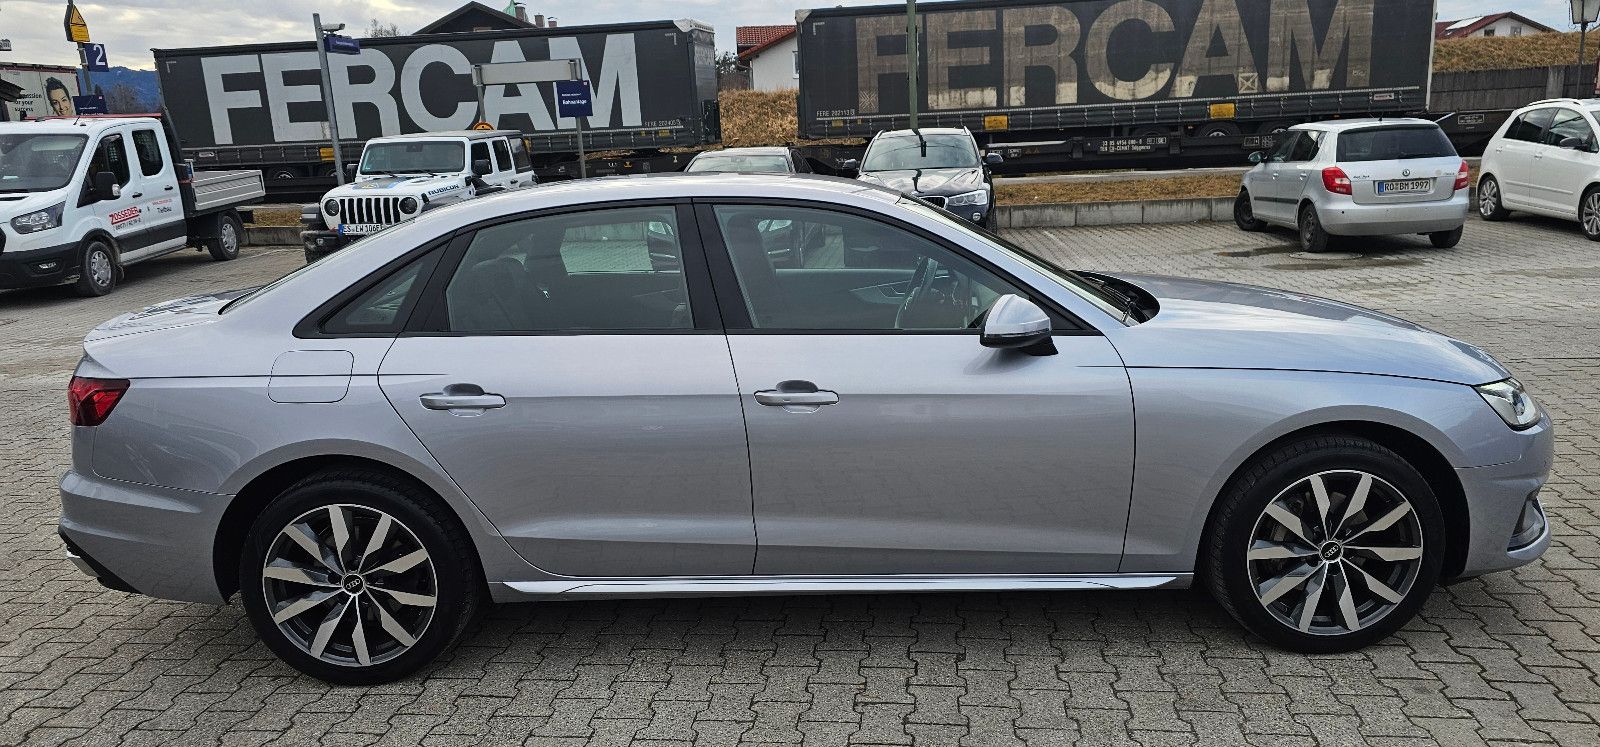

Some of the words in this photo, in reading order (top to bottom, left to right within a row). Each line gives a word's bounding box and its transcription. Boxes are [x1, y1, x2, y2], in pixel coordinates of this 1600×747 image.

[93, 44, 106, 66] 2
[857, 0, 1374, 113] FERCAM
[200, 32, 643, 145] FERCAM
[428, 184, 460, 196] RUBICON
[1384, 183, 1395, 191] RO
[1399, 182, 1410, 191] BM
[1411, 181, 1429, 190] 1997
[343, 225, 352, 233] ES
